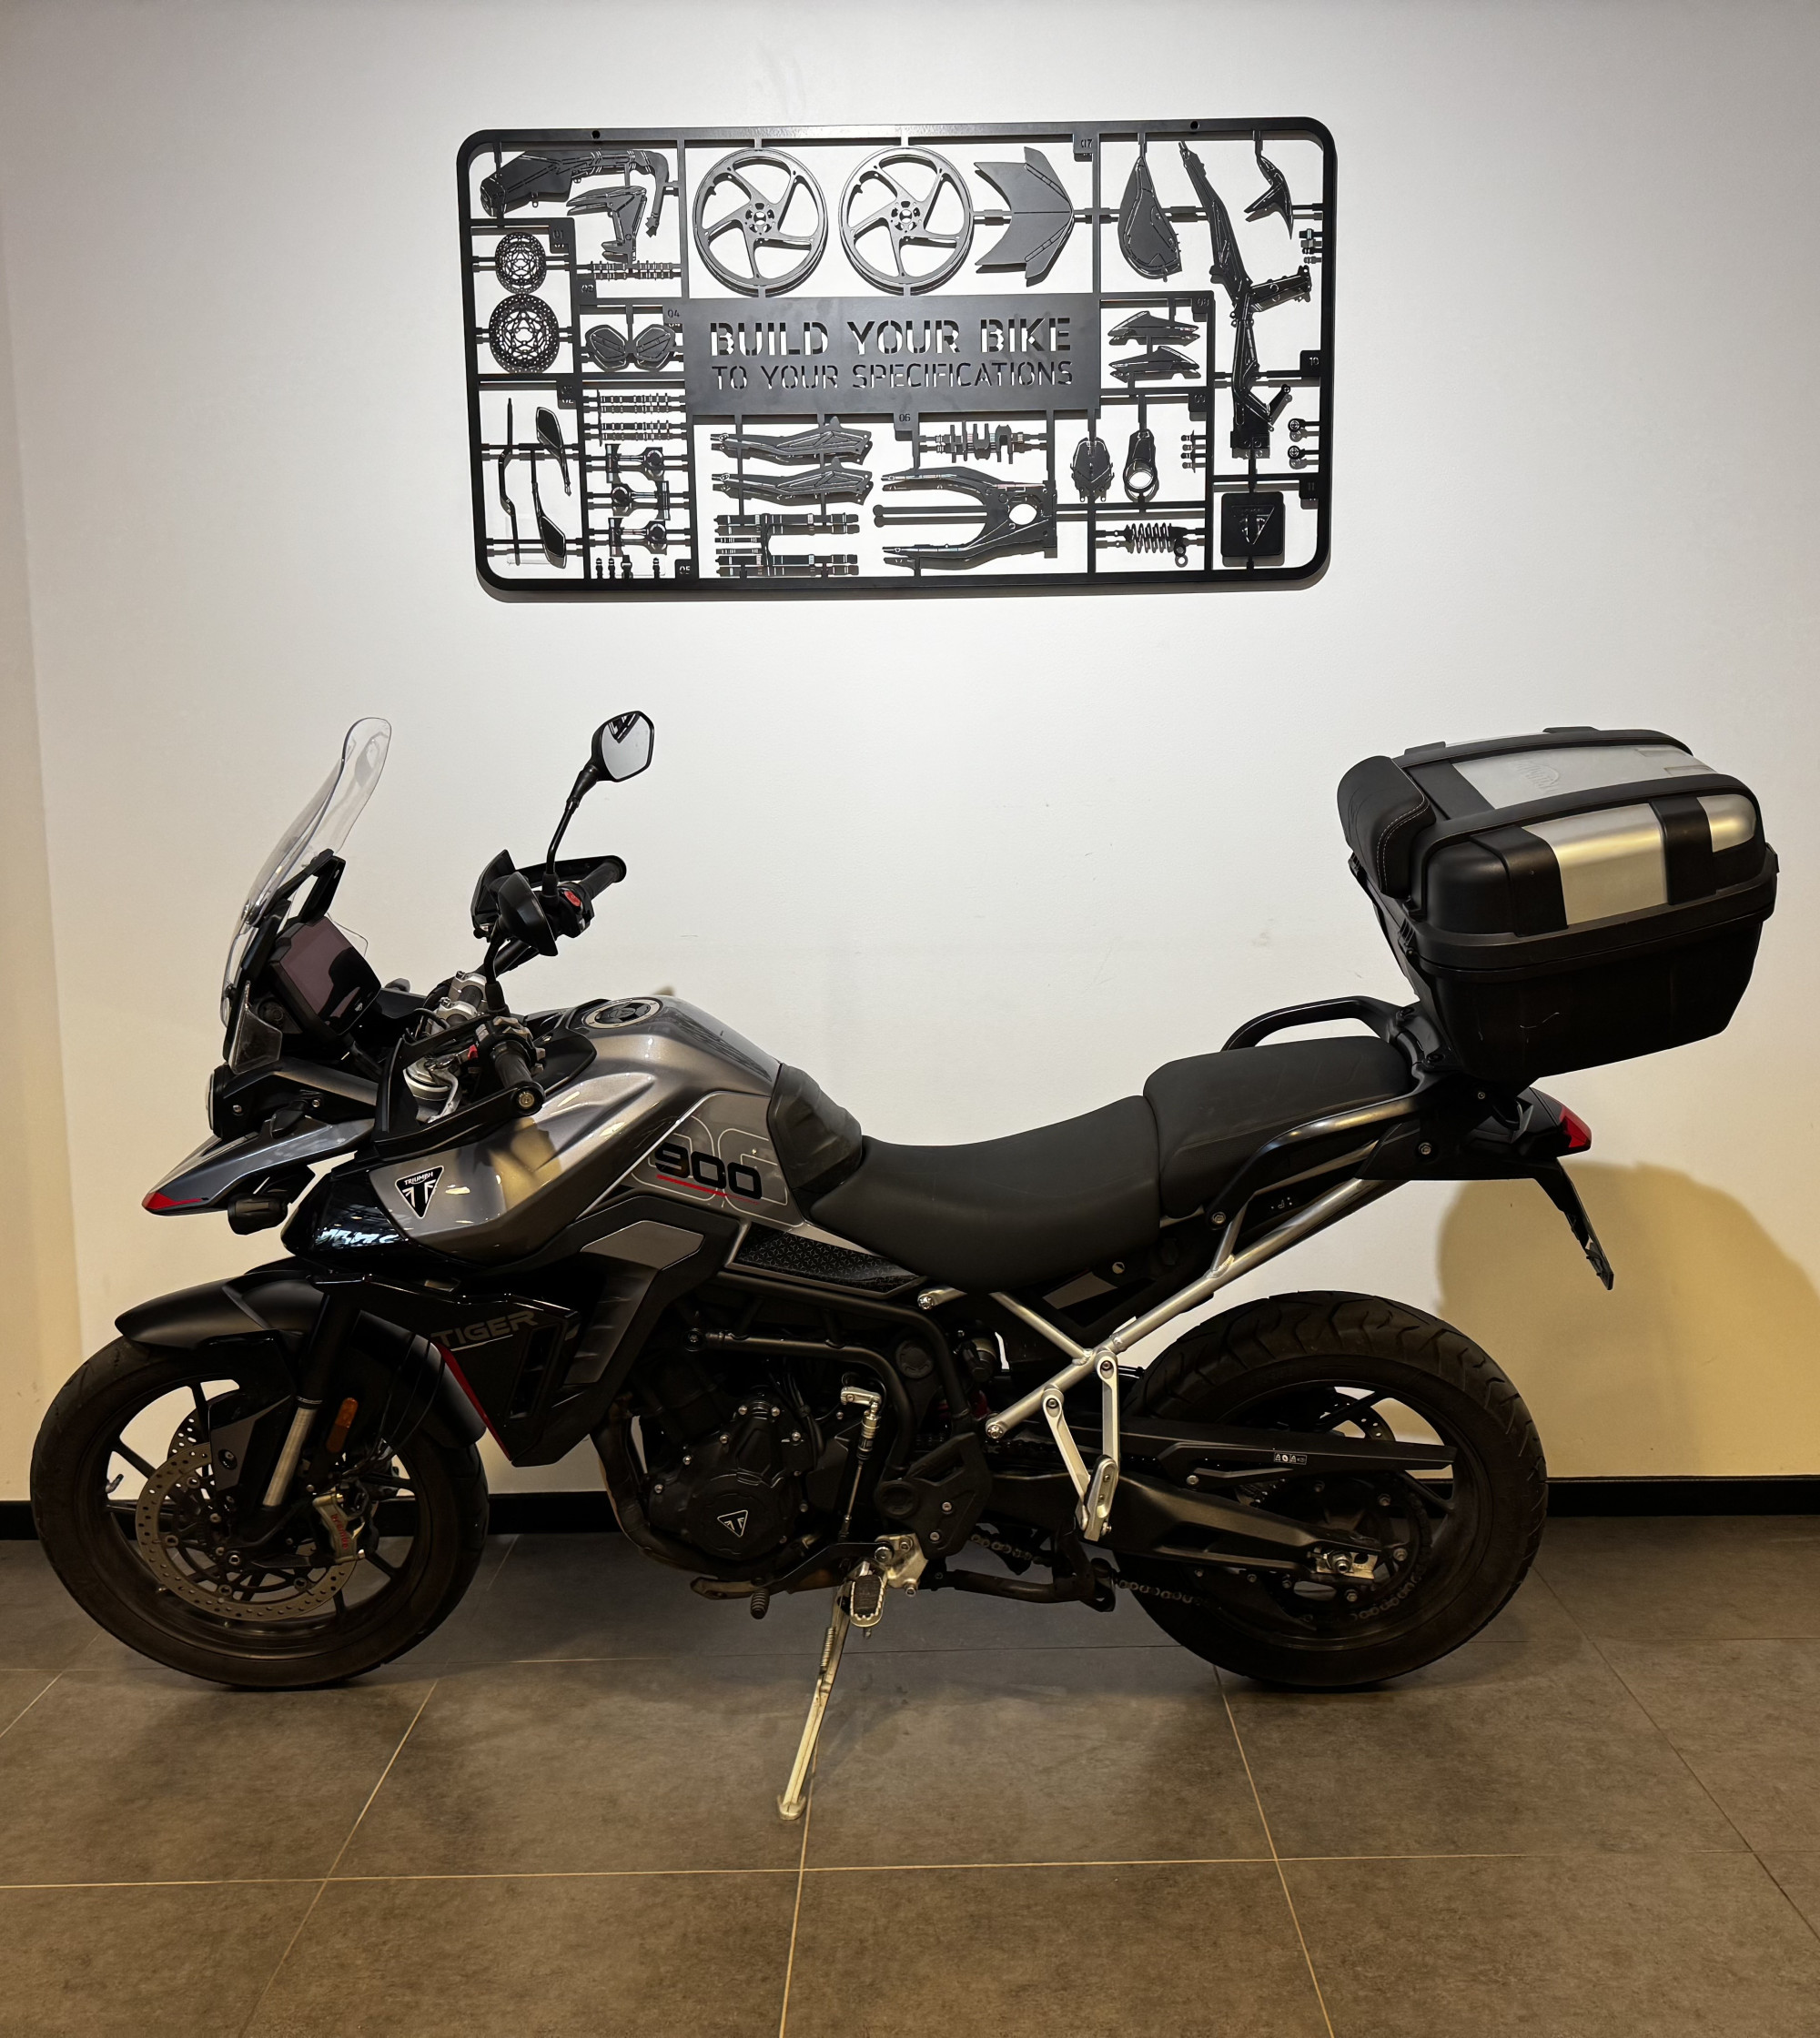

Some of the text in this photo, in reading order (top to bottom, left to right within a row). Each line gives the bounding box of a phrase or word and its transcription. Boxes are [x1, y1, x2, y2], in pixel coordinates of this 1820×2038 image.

[667, 309, 681, 318] 04
[710, 317, 1071, 356] BUILD YOUR BIKE
[712, 360, 1073, 389] TO YOUR SPECIFICATIONS
[899, 413, 911, 422] 06
[403, 1171, 434, 1185] TRIUMPH
[654, 1142, 763, 1200] 900
[430, 1310, 539, 1347] TIGER
